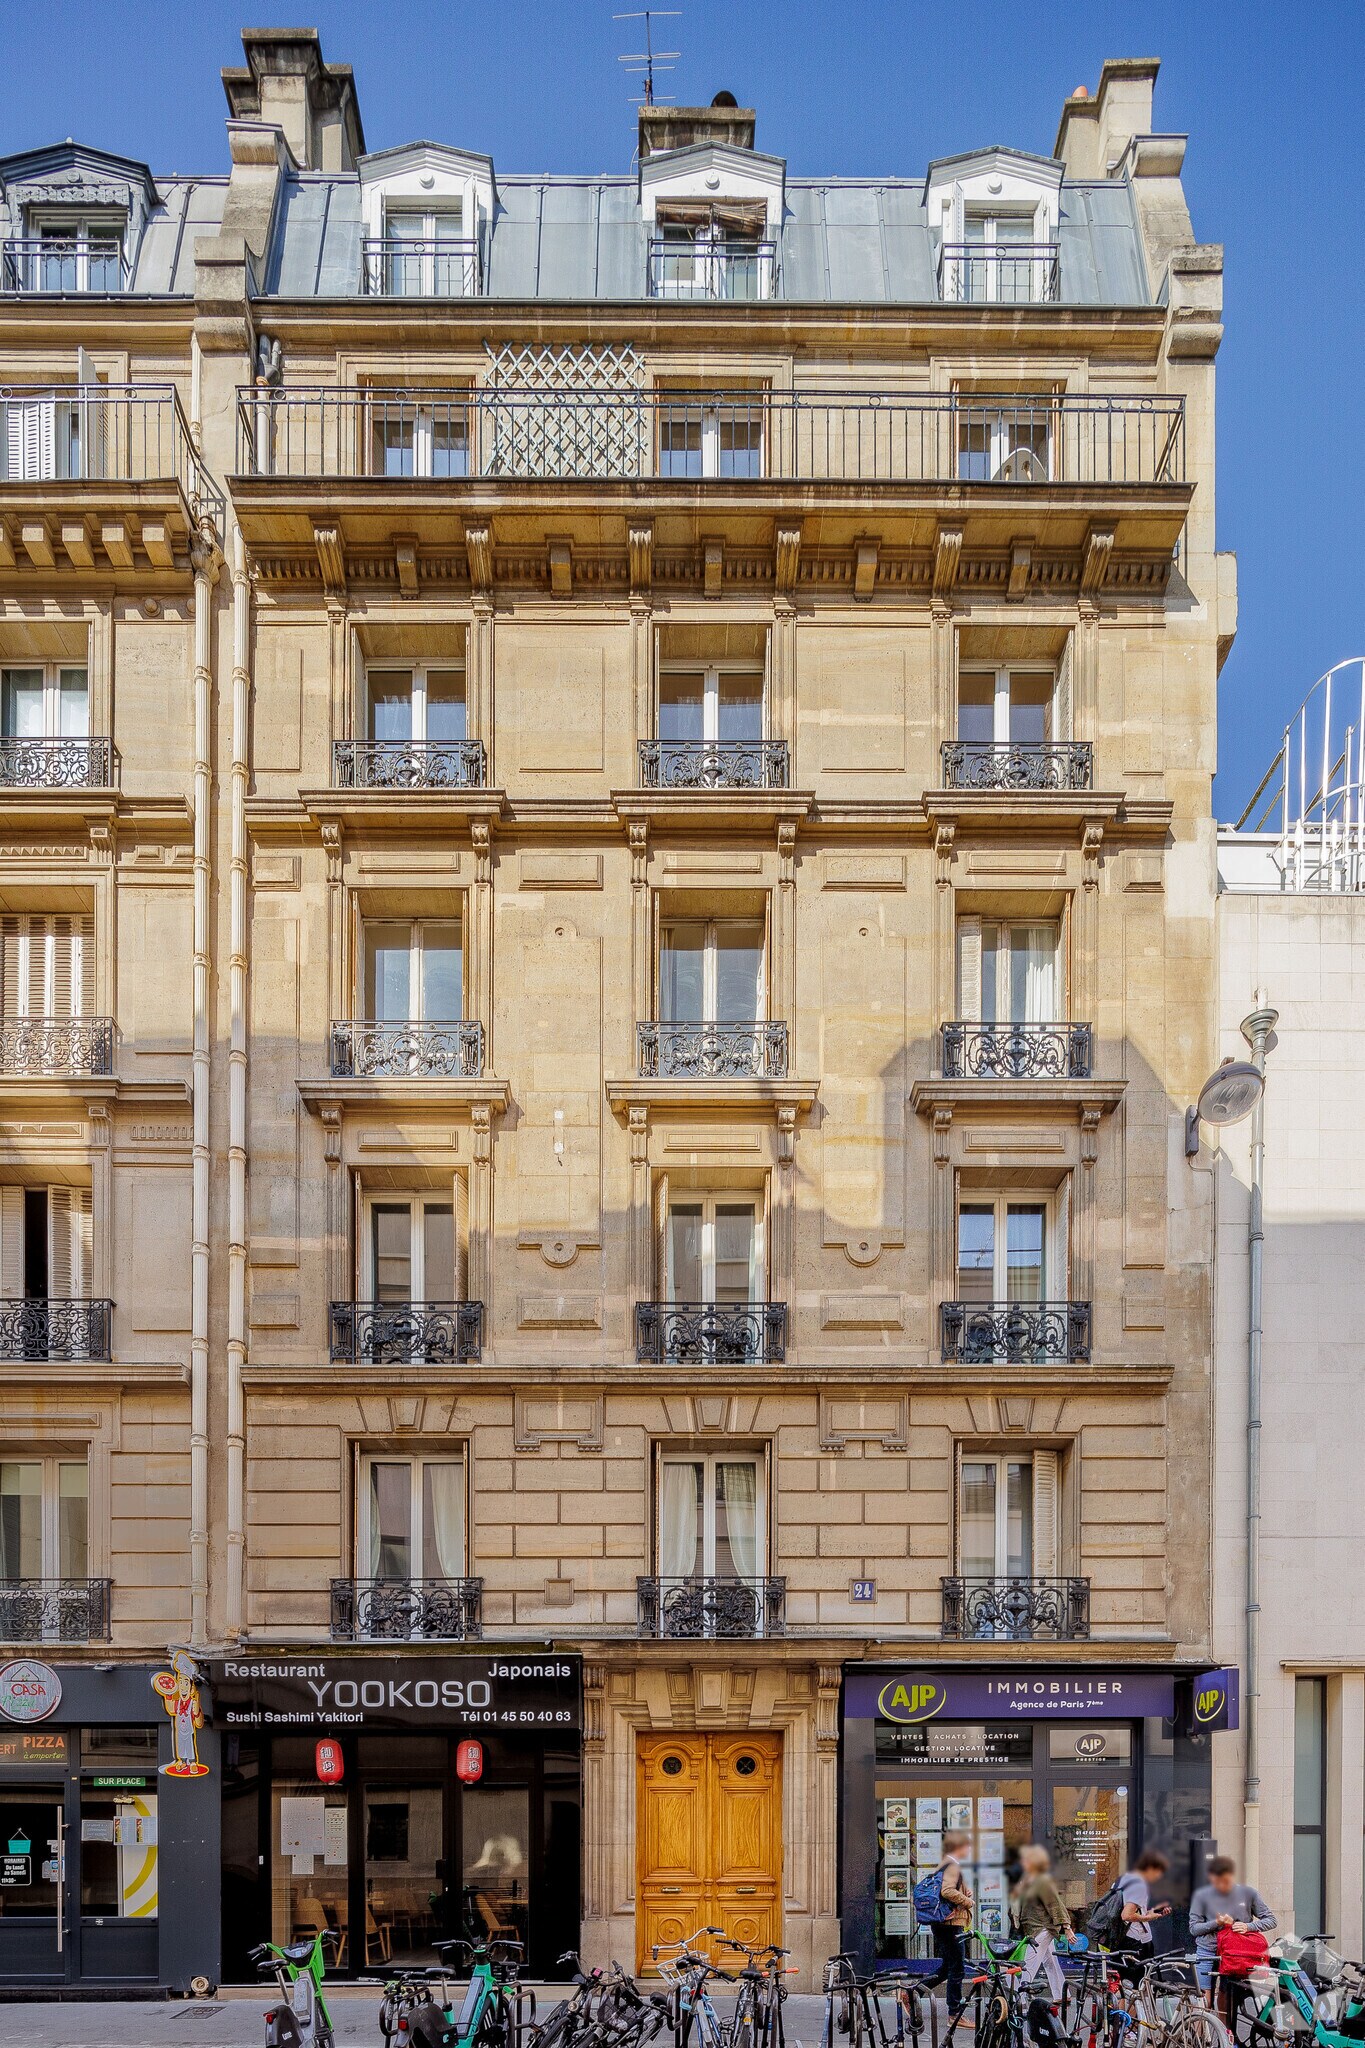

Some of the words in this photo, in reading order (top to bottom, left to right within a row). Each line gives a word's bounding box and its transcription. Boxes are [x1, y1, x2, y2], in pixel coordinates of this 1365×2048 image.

[854, 1583, 871, 1598] 24
[224, 1663, 326, 1677] Restaurant
[488, 1663, 571, 1680] Japonais
[11, 1683, 46, 1696] CASA
[307, 1680, 491, 1707] YOOKOSO
[988, 1682, 1122, 1694] IMMOBILIER
[890, 1685, 936, 1713] AJP
[1009, 1700, 1044, 1710] Agence
[1046, 1700, 1058, 1708] de
[1060, 1700, 1084, 1708] Paris
[1198, 1690, 1219, 1713] AJP
[226, 1712, 262, 1722] Sushi
[264, 1712, 314, 1722] Sashimi
[316, 1712, 363, 1722] Yakitori
[461, 1711, 480, 1722] Tél
[483, 1712, 497, 1722] 01
[501, 1712, 516, 1722] 45
[519, 1712, 535, 1722] 50
[537, 1712, 553, 1722] 40
[555, 1712, 571, 1722] 63
[23, 1736, 65, 1748] PIZZA
[1080, 1738, 1102, 1752] AJP
[29, 1752, 65, 1760] emporter
[98, 1777, 115, 1785] SUR
[116, 1777, 141, 1785] PLACE
